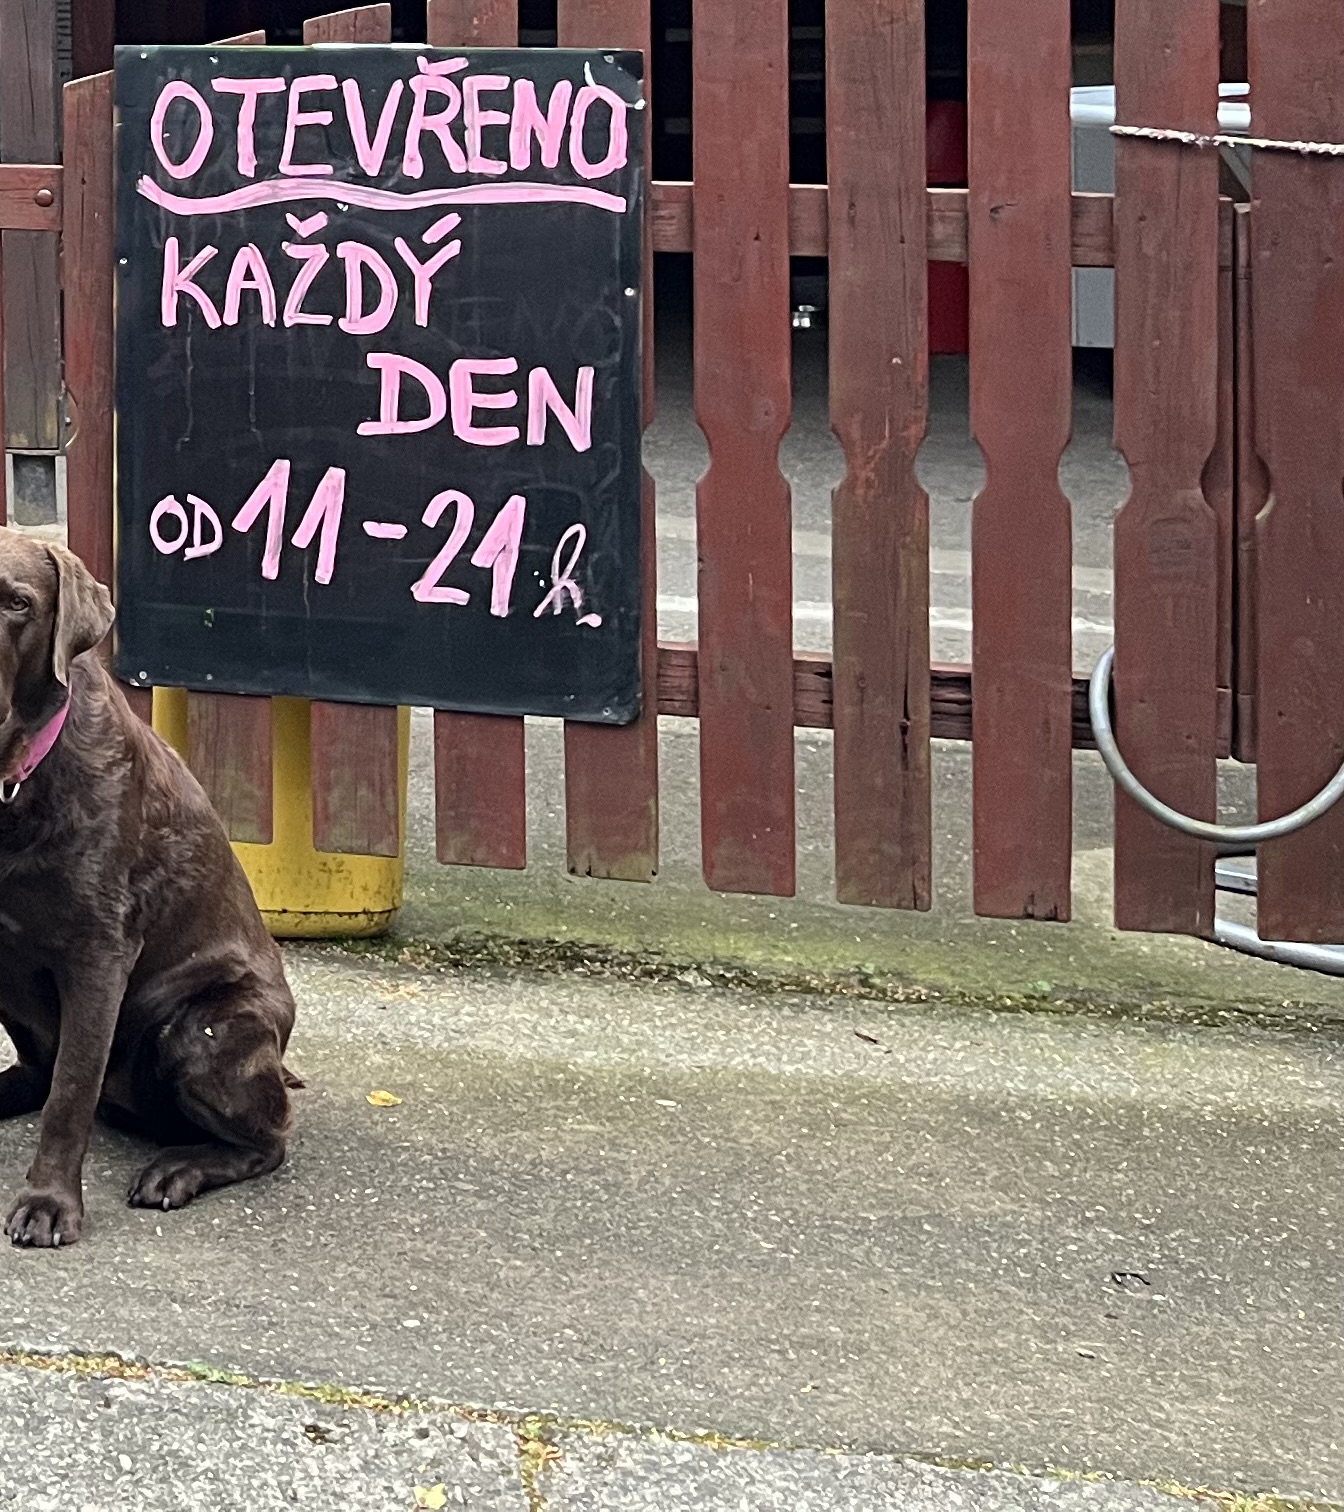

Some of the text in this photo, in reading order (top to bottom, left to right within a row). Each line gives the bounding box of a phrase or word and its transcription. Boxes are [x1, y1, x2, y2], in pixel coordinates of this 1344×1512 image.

[149, 55, 629, 181] OTEVŘENO
[161, 211, 462, 334] KAŽDÝ
[357, 352, 594, 453] DEN
[149, 492, 224, 561] OD
